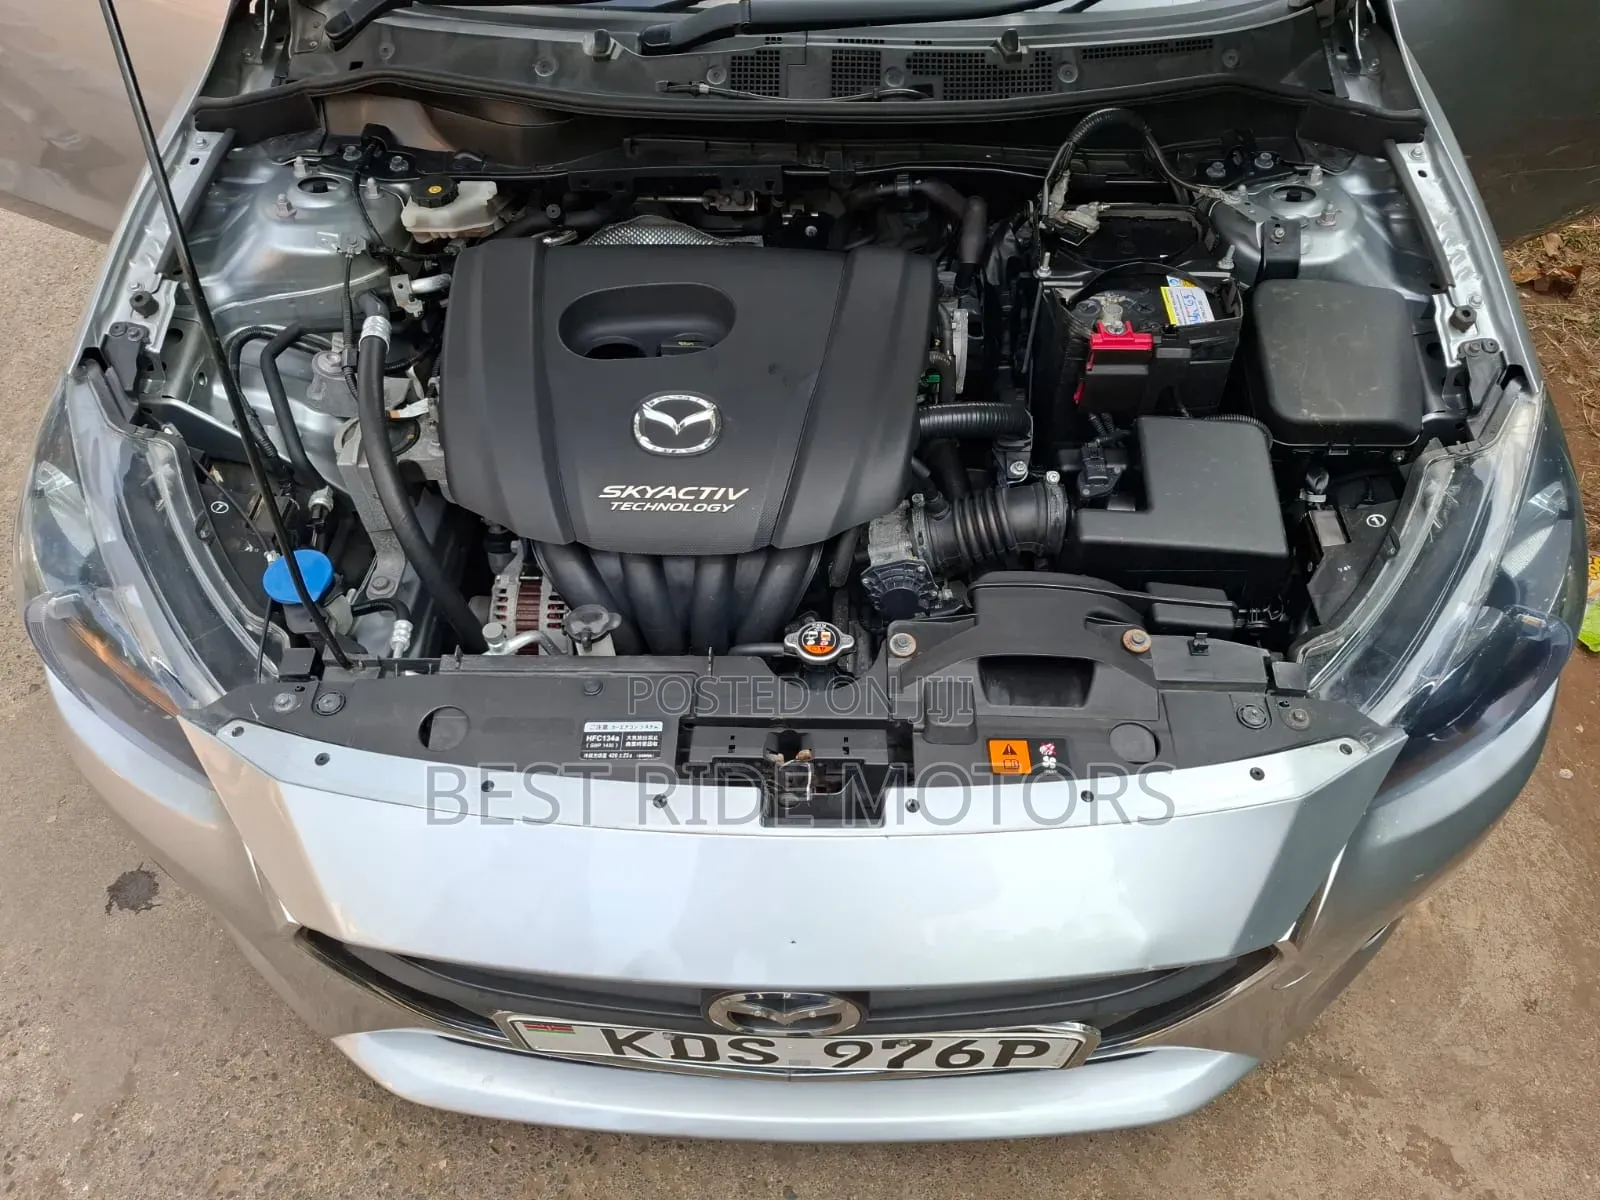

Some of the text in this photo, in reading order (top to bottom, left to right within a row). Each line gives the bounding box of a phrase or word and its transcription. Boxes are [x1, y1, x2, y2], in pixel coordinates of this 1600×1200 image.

[598, 485, 750, 500] SKYACTIV
[610, 502, 735, 512] TECHNOLOGY
[600, 1028, 779, 1064] KDS
[823, 1039, 1051, 1069] 976P
